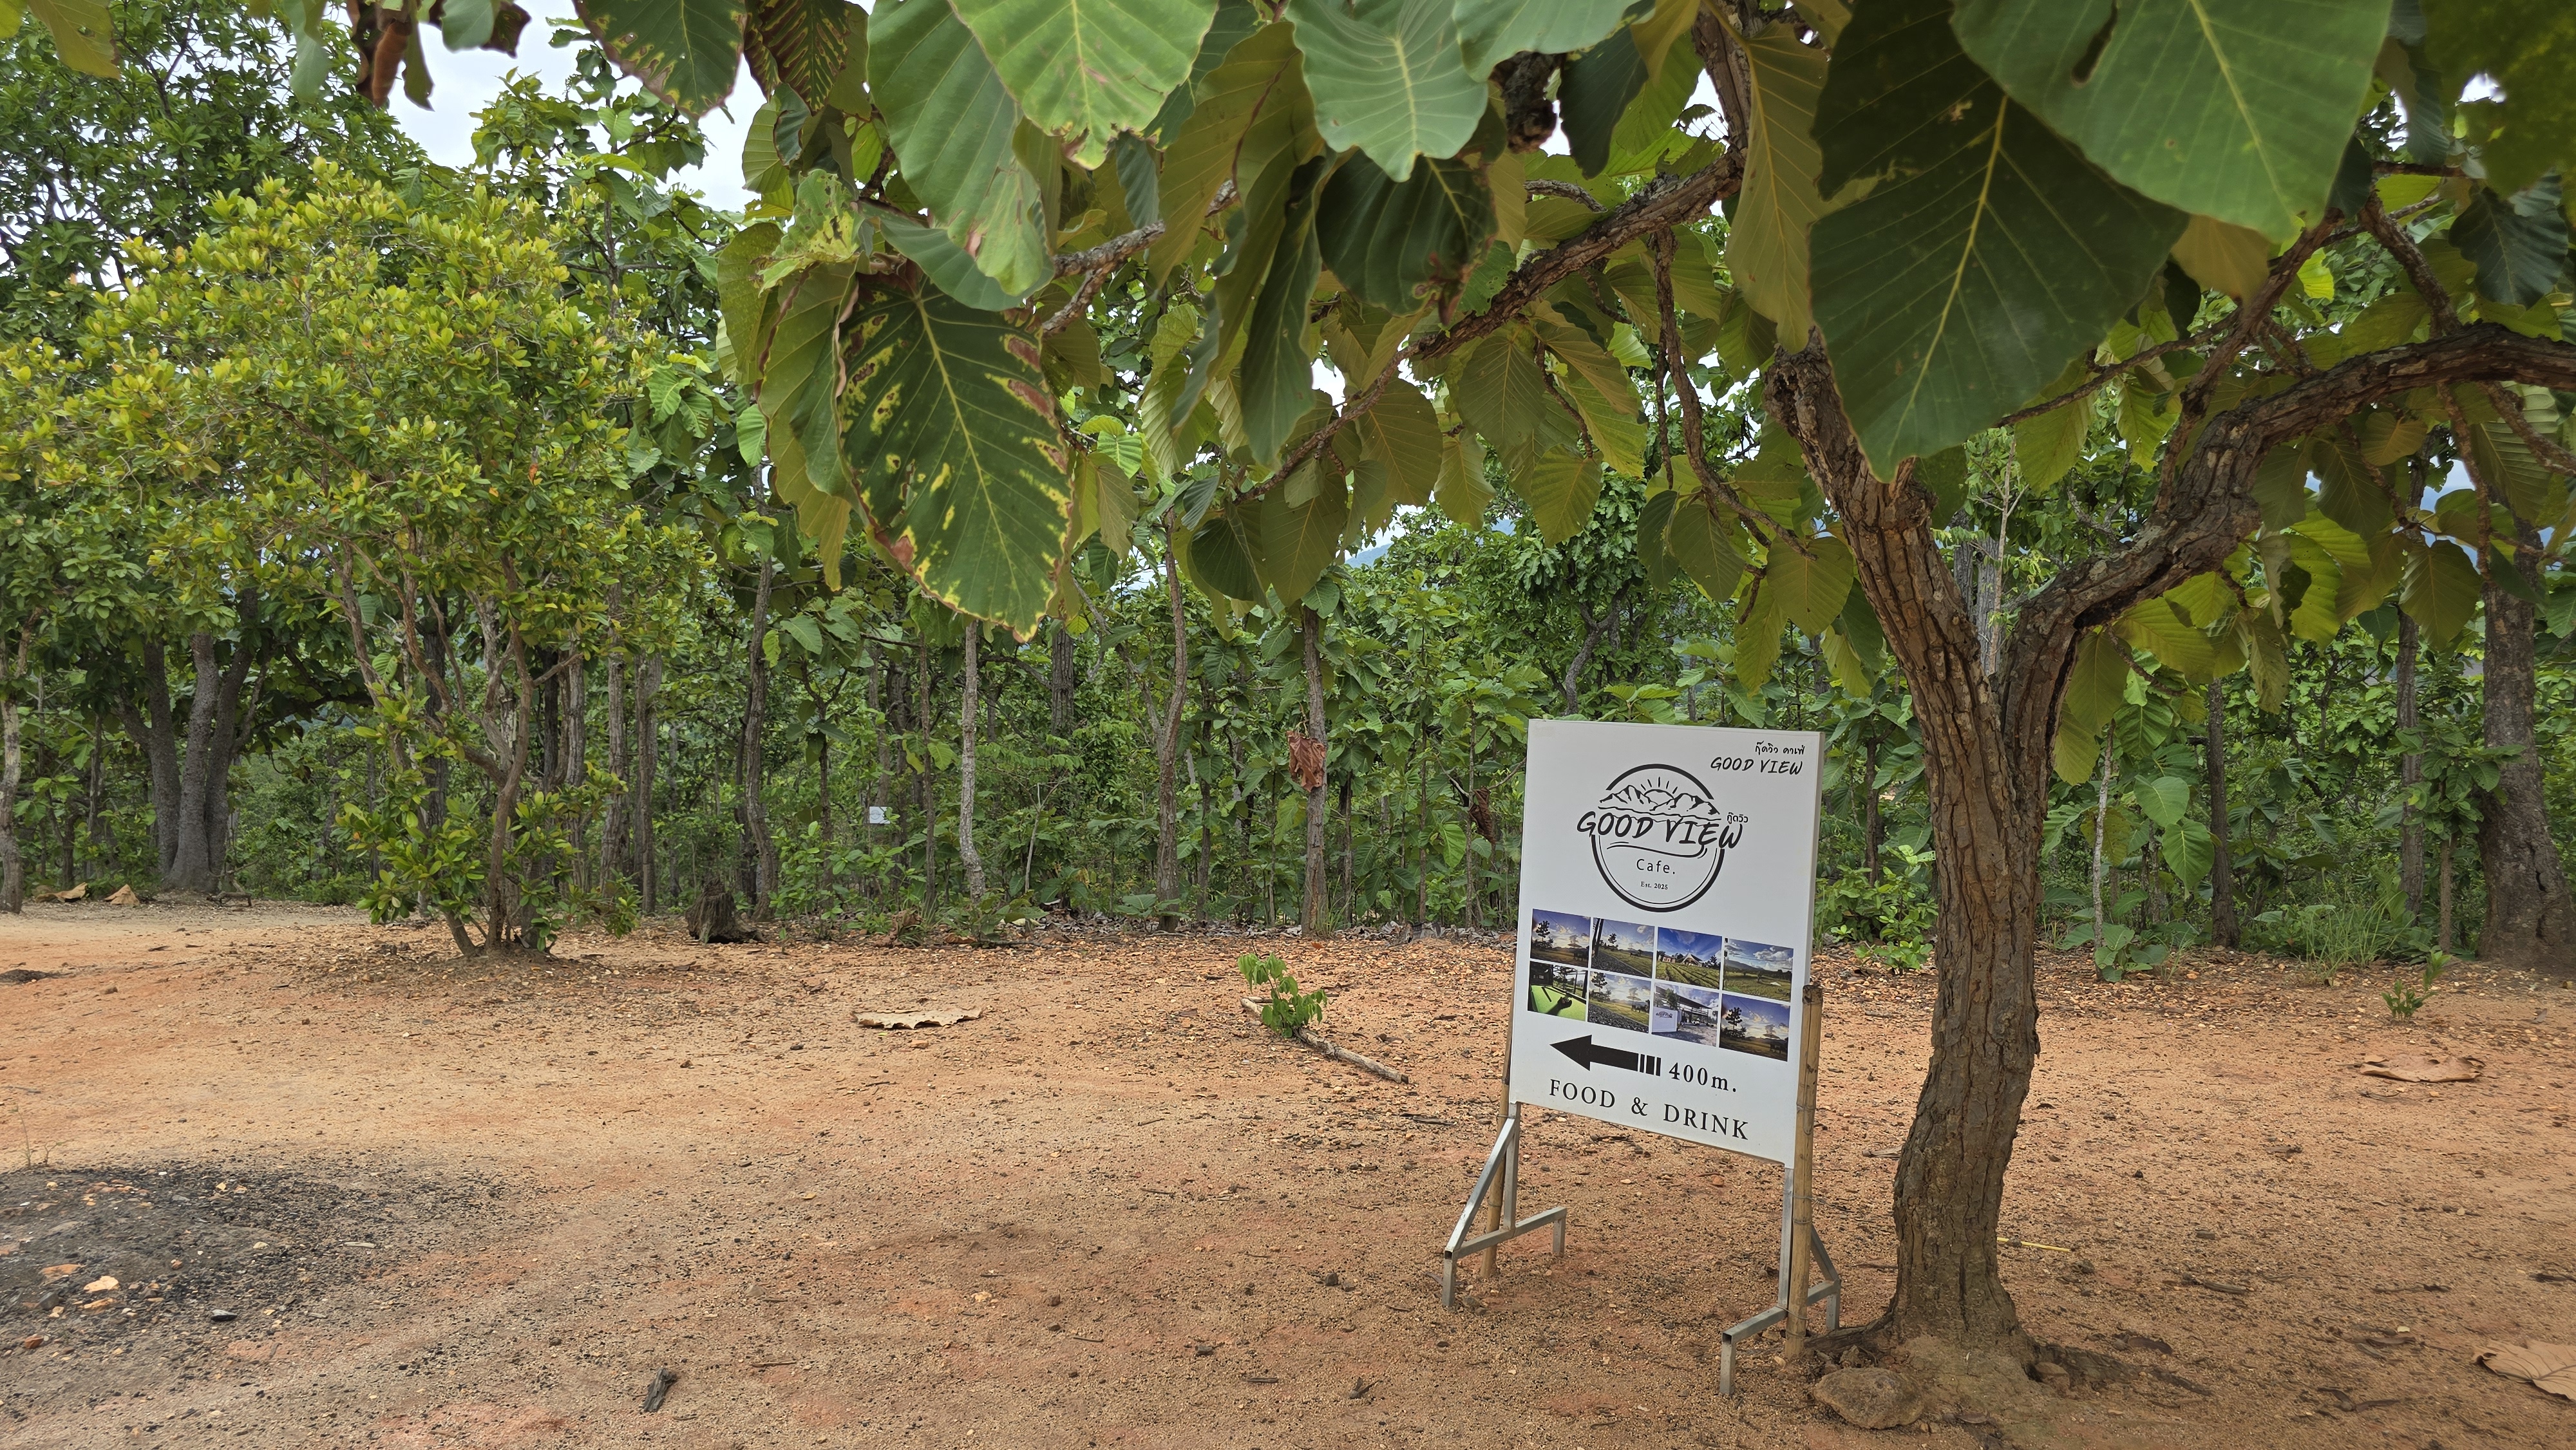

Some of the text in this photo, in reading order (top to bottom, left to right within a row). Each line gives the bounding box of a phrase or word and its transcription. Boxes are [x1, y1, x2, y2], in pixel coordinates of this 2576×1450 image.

[1783, 745, 1806, 755] คาเฟ่
[1710, 757, 1803, 775] GOOD VIEW
[1577, 811, 1743, 849] GOOD VIEW
[1636, 858, 1676, 875] Cafe.
[1668, 1062, 1737, 1093] 400m.
[1549, 1078, 1748, 1140] FOOD & DRINK
